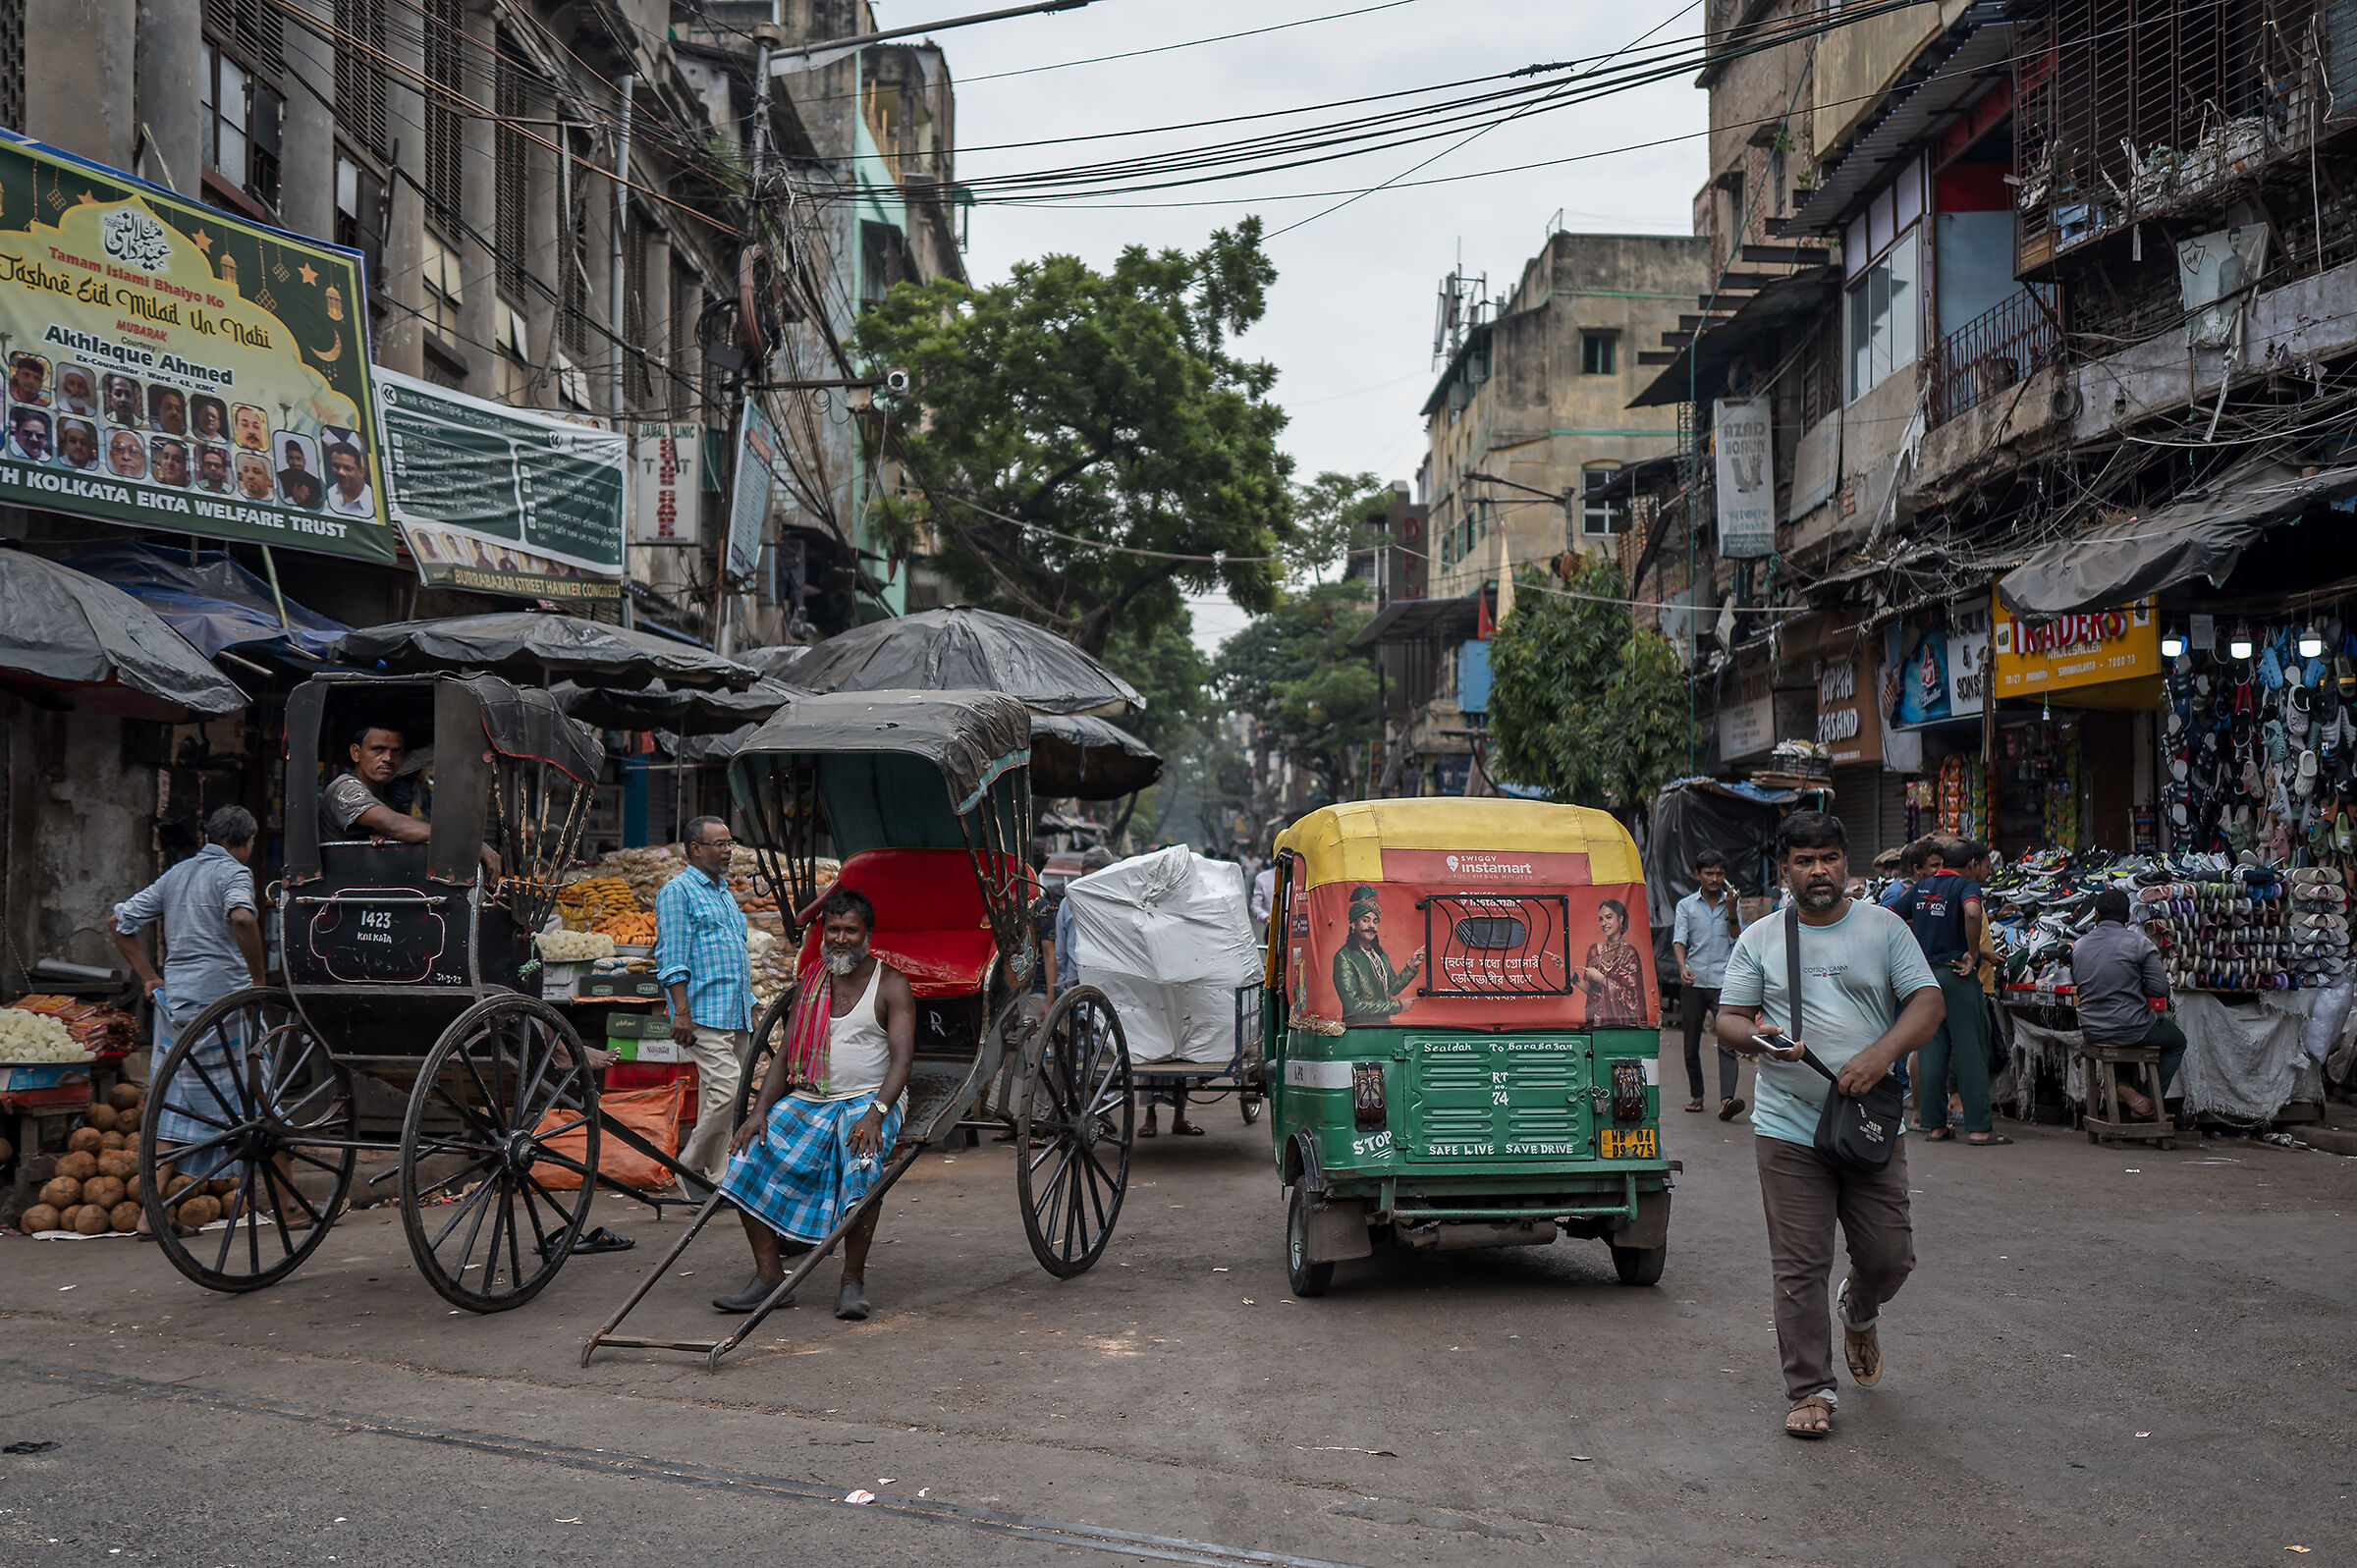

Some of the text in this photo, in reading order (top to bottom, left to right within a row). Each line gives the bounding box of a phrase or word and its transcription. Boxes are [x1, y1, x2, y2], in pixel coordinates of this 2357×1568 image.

[48, 245, 225, 308] Tamam Islami Bhaiyo Ko
[78, 276, 112, 306] Eid
[116, 289, 181, 326] Milad
[191, 308, 216, 336] Un
[221, 317, 273, 350] Nabi
[116, 320, 168, 342] MUBARAK
[121, 337, 156, 352] Courtesy
[45, 325, 234, 386] Akhlaque Ahmed
[76, 354, 138, 375] Ex-Councillor
[147, 372, 171, 383] Ward
[672, 425, 694, 439] LINIC
[1724, 422, 1766, 438] AZAD
[27, 470, 132, 505] KOLKATA
[137, 491, 191, 514] EKTA
[194, 501, 285, 528] WELFARE
[289, 515, 347, 538] TRUST
[455, 569, 516, 590] BURRABAZAR
[516, 576, 545, 593] STREET
[546, 580, 581, 597] HAWKER
[582, 583, 621, 598] CONGRESS
[1462, 862, 1532, 874] instamart
[361, 910, 392, 929] 1423
[1424, 1043, 1472, 1053] Sealdah
[1489, 1043, 1505, 1053] To
[1492, 1072, 1509, 1084] RT
[1492, 1092, 1509, 1106] 74
[1353, 1130, 1393, 1155] STOP
[1612, 1130, 1626, 1143] WB
[1636, 1130, 1651, 1143] 04
[1429, 1146, 1458, 1156] SAFE
[1506, 1144, 1538, 1155] SAVE
[1541, 1143, 1573, 1155] DRIVE
